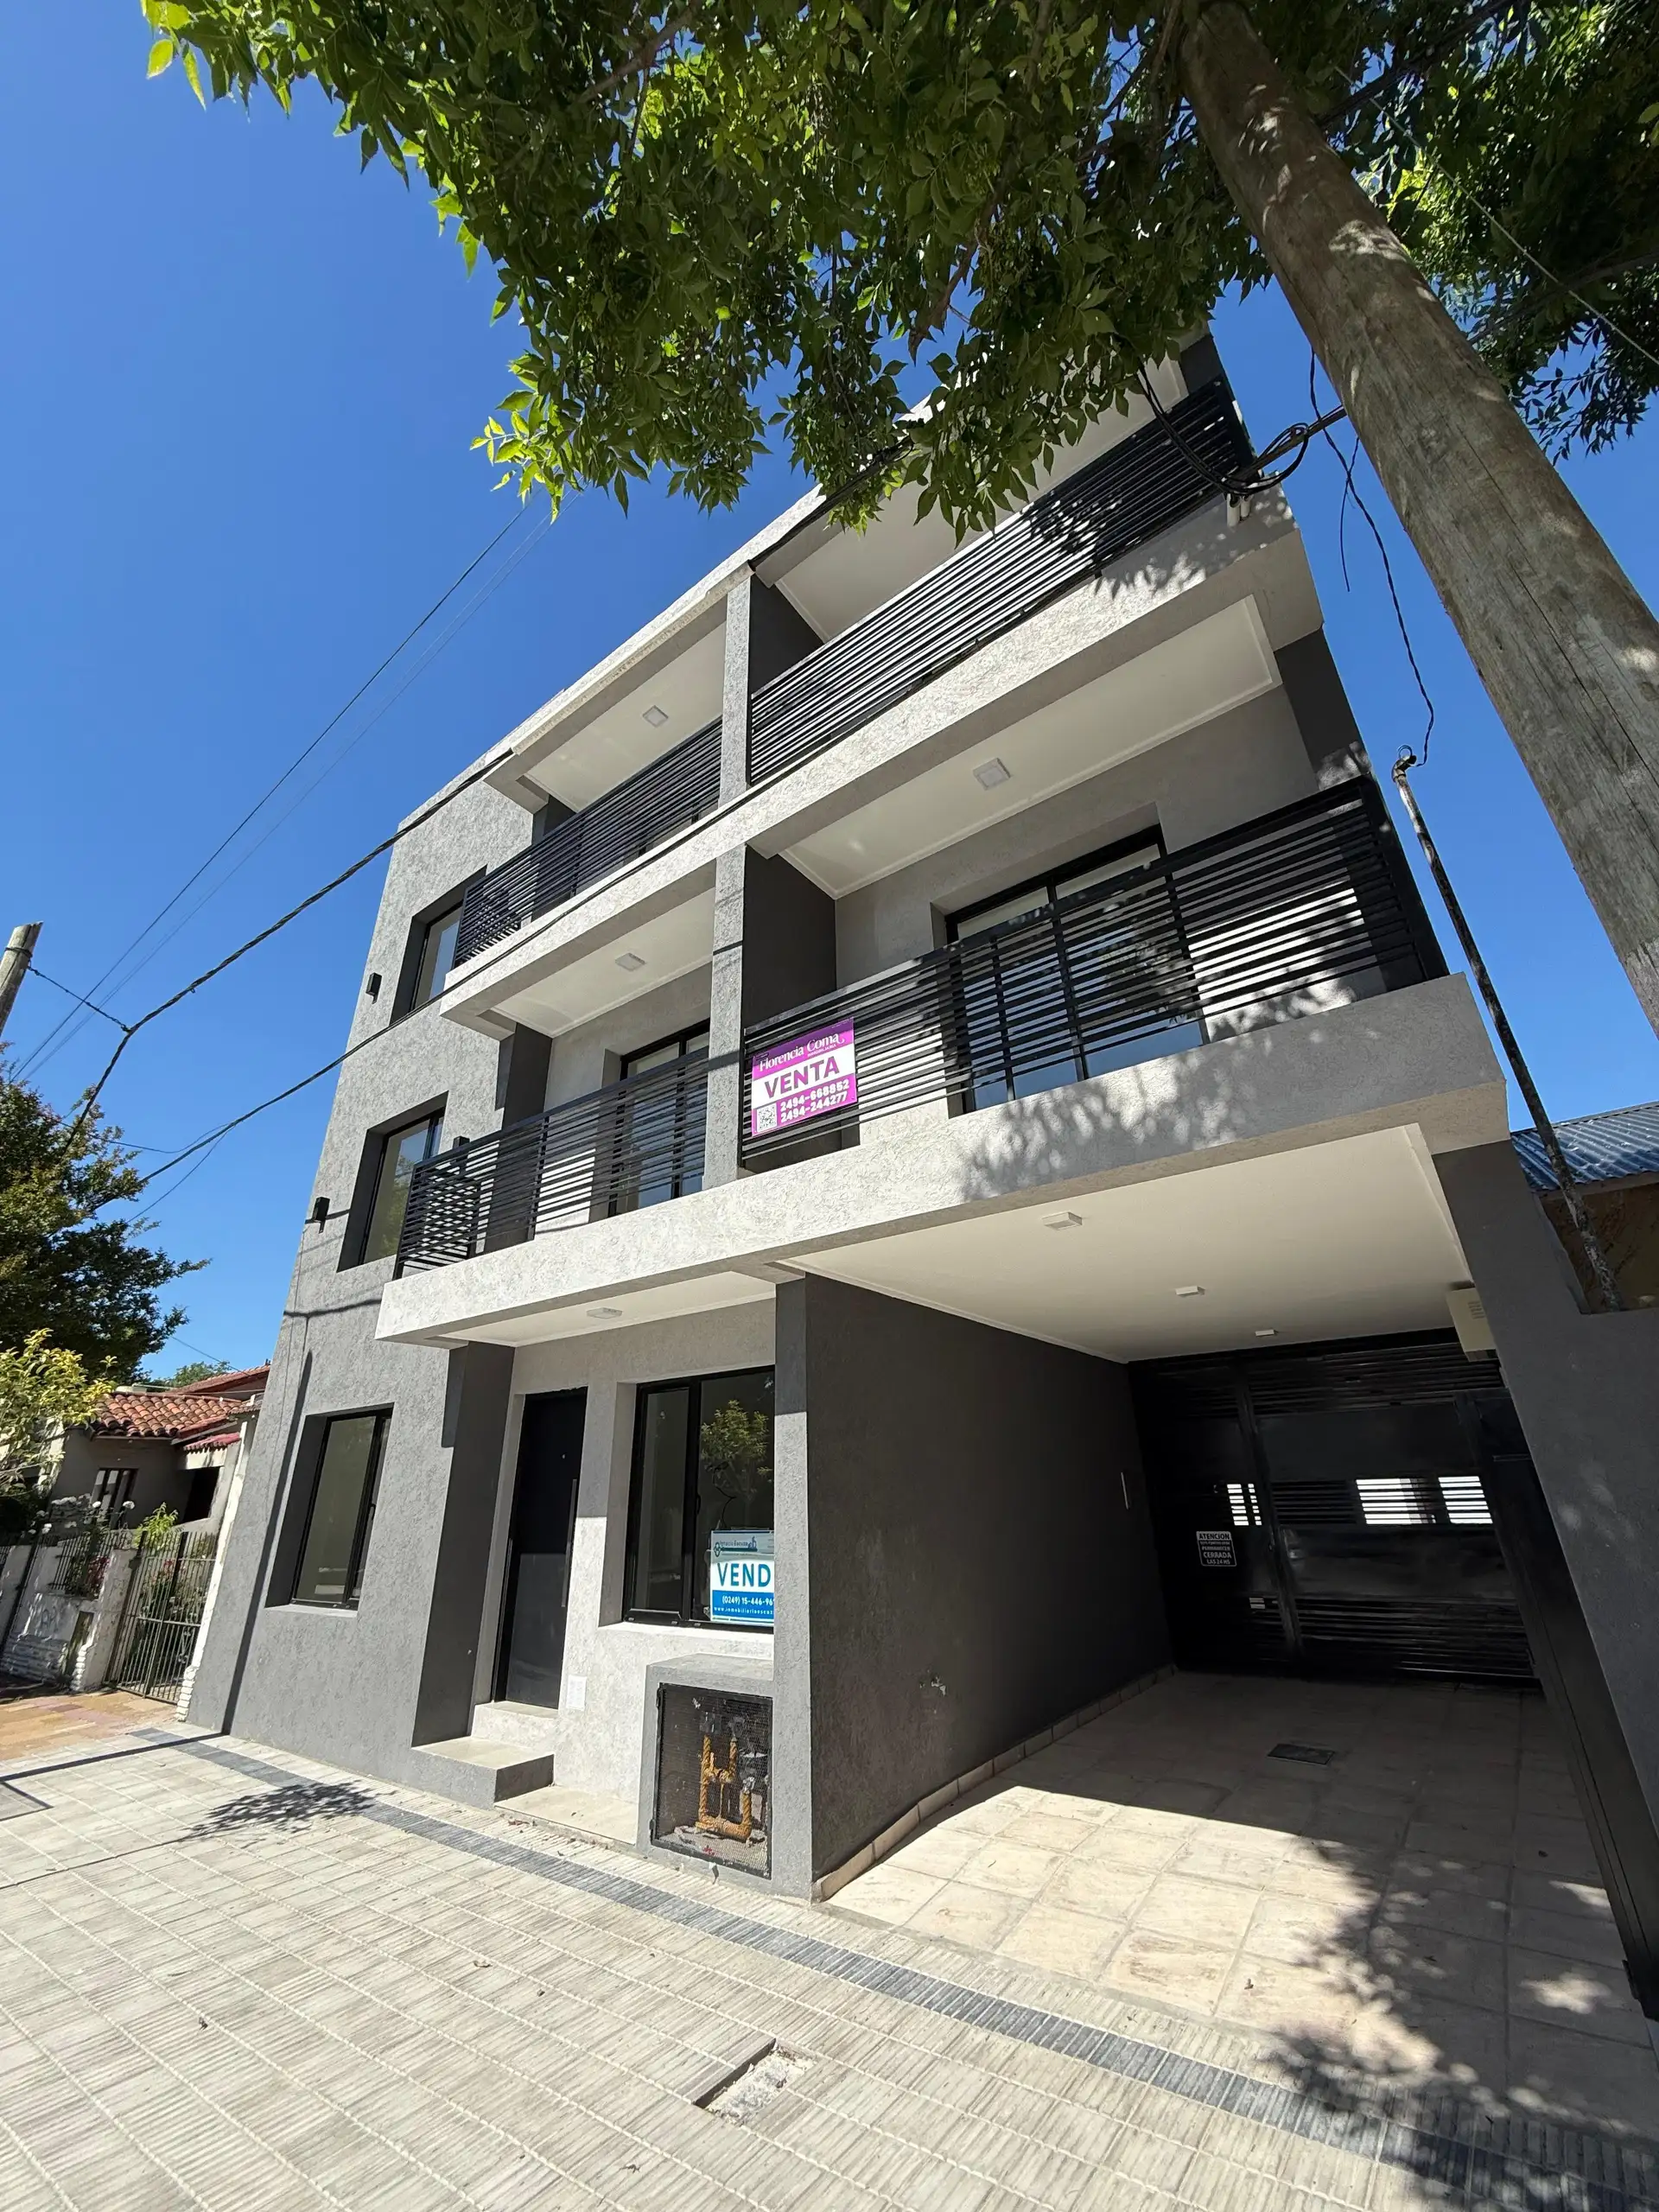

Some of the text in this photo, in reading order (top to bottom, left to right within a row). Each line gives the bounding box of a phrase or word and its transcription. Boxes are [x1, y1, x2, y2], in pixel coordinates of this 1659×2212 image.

[760, 1046, 804, 1072] Florencia
[806, 1033, 845, 1052] Coma
[764, 1056, 840, 1099] VENTA
[780, 1091, 848, 1123] 2494-244277
[717, 1562, 771, 1587] VEND
[721, 1595, 774, 1606] (0249) 15-446-96
